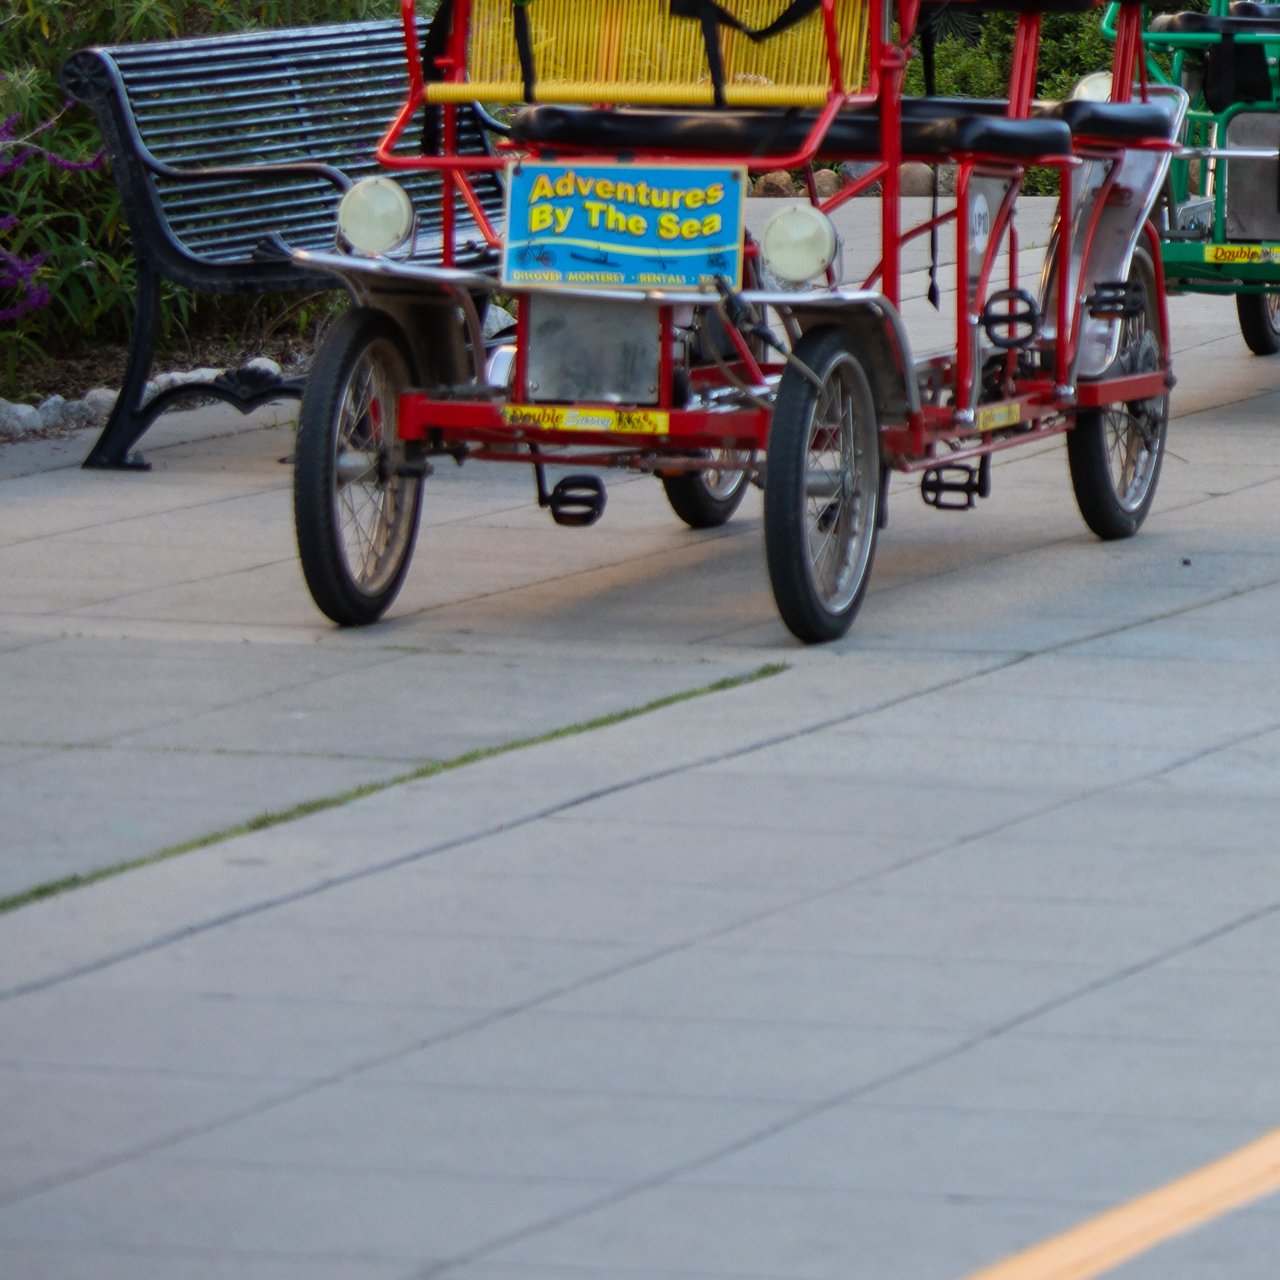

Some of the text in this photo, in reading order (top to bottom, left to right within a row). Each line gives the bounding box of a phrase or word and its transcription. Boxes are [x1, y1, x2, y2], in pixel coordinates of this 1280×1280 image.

[529, 171, 725, 210] Adventures
[529, 200, 722, 240] By The Sea
[1213, 247, 1259, 260] Double
[510, 408, 564, 426] Double
